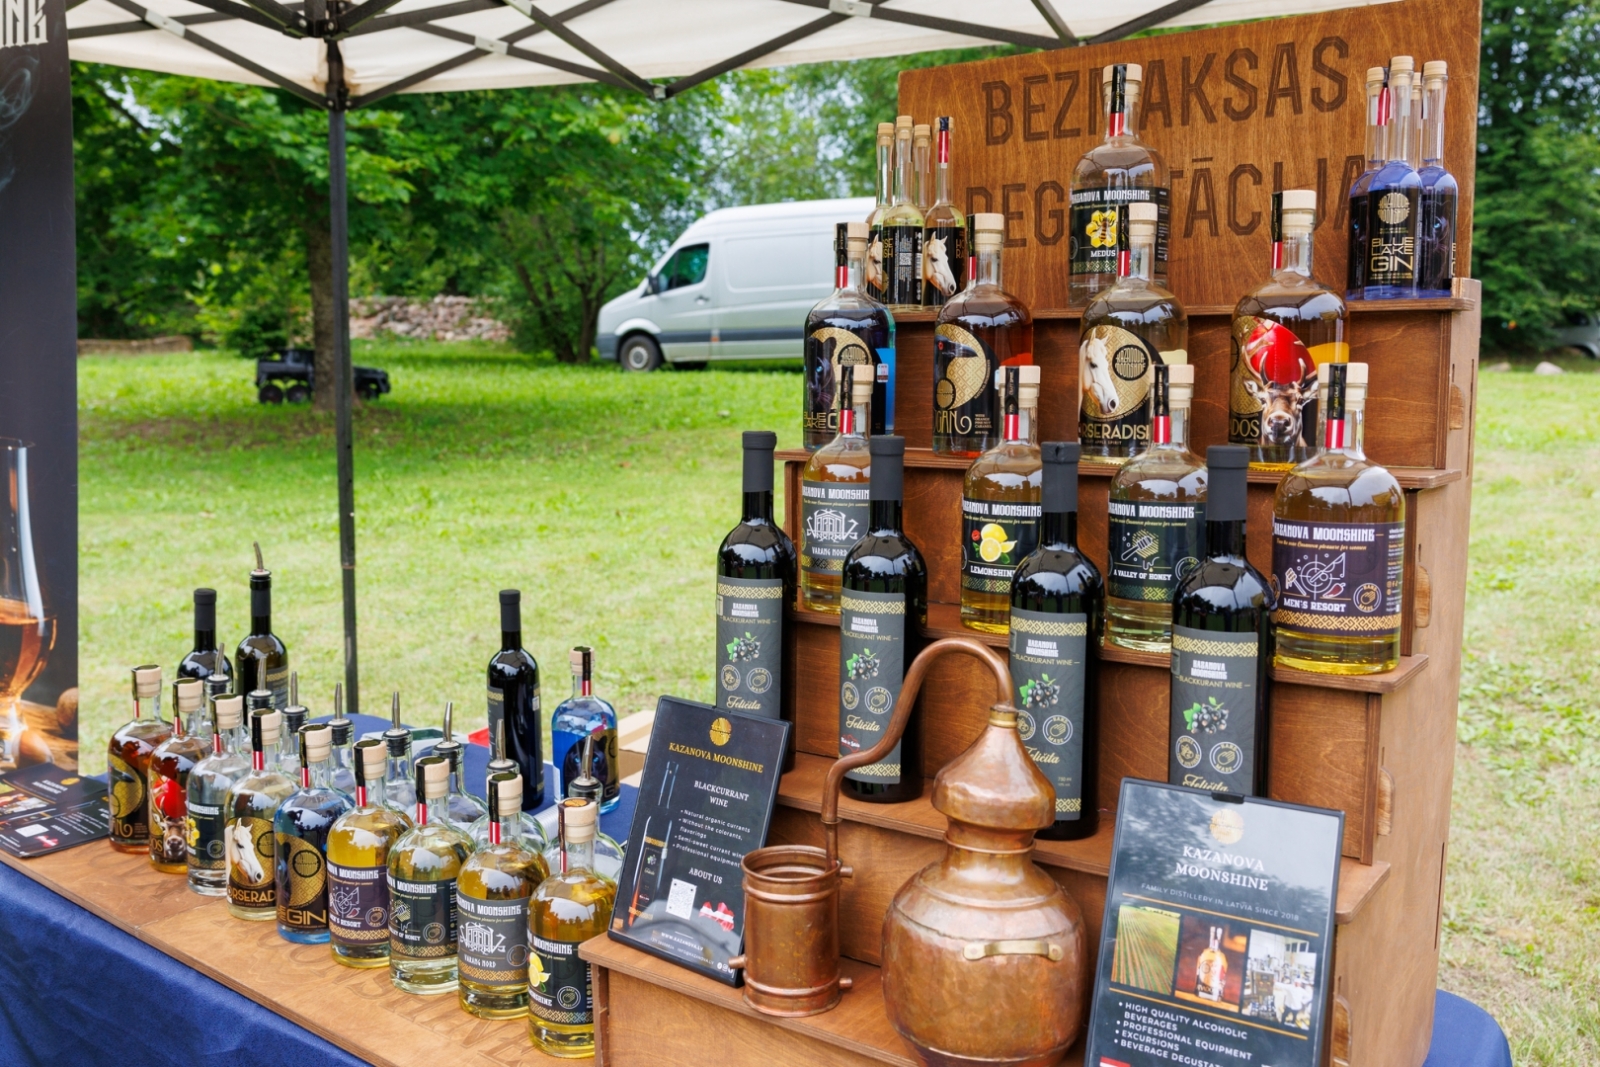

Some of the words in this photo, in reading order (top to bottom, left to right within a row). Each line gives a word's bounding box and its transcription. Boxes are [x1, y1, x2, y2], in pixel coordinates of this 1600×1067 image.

[1104, 189, 1150, 200] MOONSHINE
[1372, 236, 1414, 247] BLUE
[1090, 250, 1116, 258] MEDUS
[1372, 246, 1414, 256] LAKE
[1370, 256, 1414, 272] GIN
[1080, 423, 1150, 440] RSERADIS
[803, 486, 826, 498] AZANOVA
[828, 488, 870, 500] MOONSHIN
[963, 500, 989, 514] AZANOVA
[992, 504, 1042, 517] MOONSHINE
[1108, 502, 1136, 517] AZANOVA
[1139, 505, 1194, 518] MOONSHINE
[1313, 527, 1375, 542] MOONSHINE
[812, 546, 831, 555] VARANG
[970, 565, 1016, 578] LEMONSHIN
[1118, 570, 1138, 578] VALLEY
[1284, 598, 1308, 609] MEN'S
[1310, 602, 1346, 612] RESORT
[669, 742, 711, 760] KAZANOVA
[713, 753, 764, 773] MOONSHINE
[694, 780, 749, 801] BLACKCURRANT
[709, 796, 728, 808] WINE
[682, 818, 704, 828] Without
[684, 810, 704, 819] Natural
[705, 816, 725, 826] organic
[727, 822, 750, 833] currants
[680, 826, 707, 838] flavorings
[678, 835, 708, 848] Semi-sweet
[710, 846, 730, 855] currant
[676, 843, 709, 858] Professional
[710, 855, 740, 868] equipment
[1183, 846, 1265, 872] KAZANOVA
[688, 868, 712, 880] ABOUT
[713, 874, 723, 884] US
[1175, 863, 1268, 891] MOONSHINE
[228, 886, 276, 902] ORSERAD
[397, 880, 437, 893] MOONSHINE
[477, 904, 521, 916] MOONSHINE
[1141, 882, 1168, 894] FAMILY
[1170, 888, 1213, 903] DISTILLERY
[1215, 898, 1223, 906] IN
[1225, 900, 1253, 912] LATVIA
[1255, 906, 1278, 917] SINCE
[1281, 912, 1299, 922] 2018
[287, 909, 327, 925] GIN
[533, 936, 572, 955] MOONSHINE
[1124, 1011, 1178, 1031] BEVERAGES
[1125, 1002, 1148, 1014] HIGH
[1151, 1009, 1190, 1024] QUALITY
[1192, 1019, 1248, 1039] ALCOHOLIC
[1122, 1030, 1180, 1051] EXCURSIONS
[1123, 1020, 1192, 1045] PROFESSIONAL
[1195, 1040, 1253, 1060] EQUIPMENT
[1120, 1039, 1168, 1058] BEVERAGE
[1171, 1053, 1223, 1067] DEGUSTA
